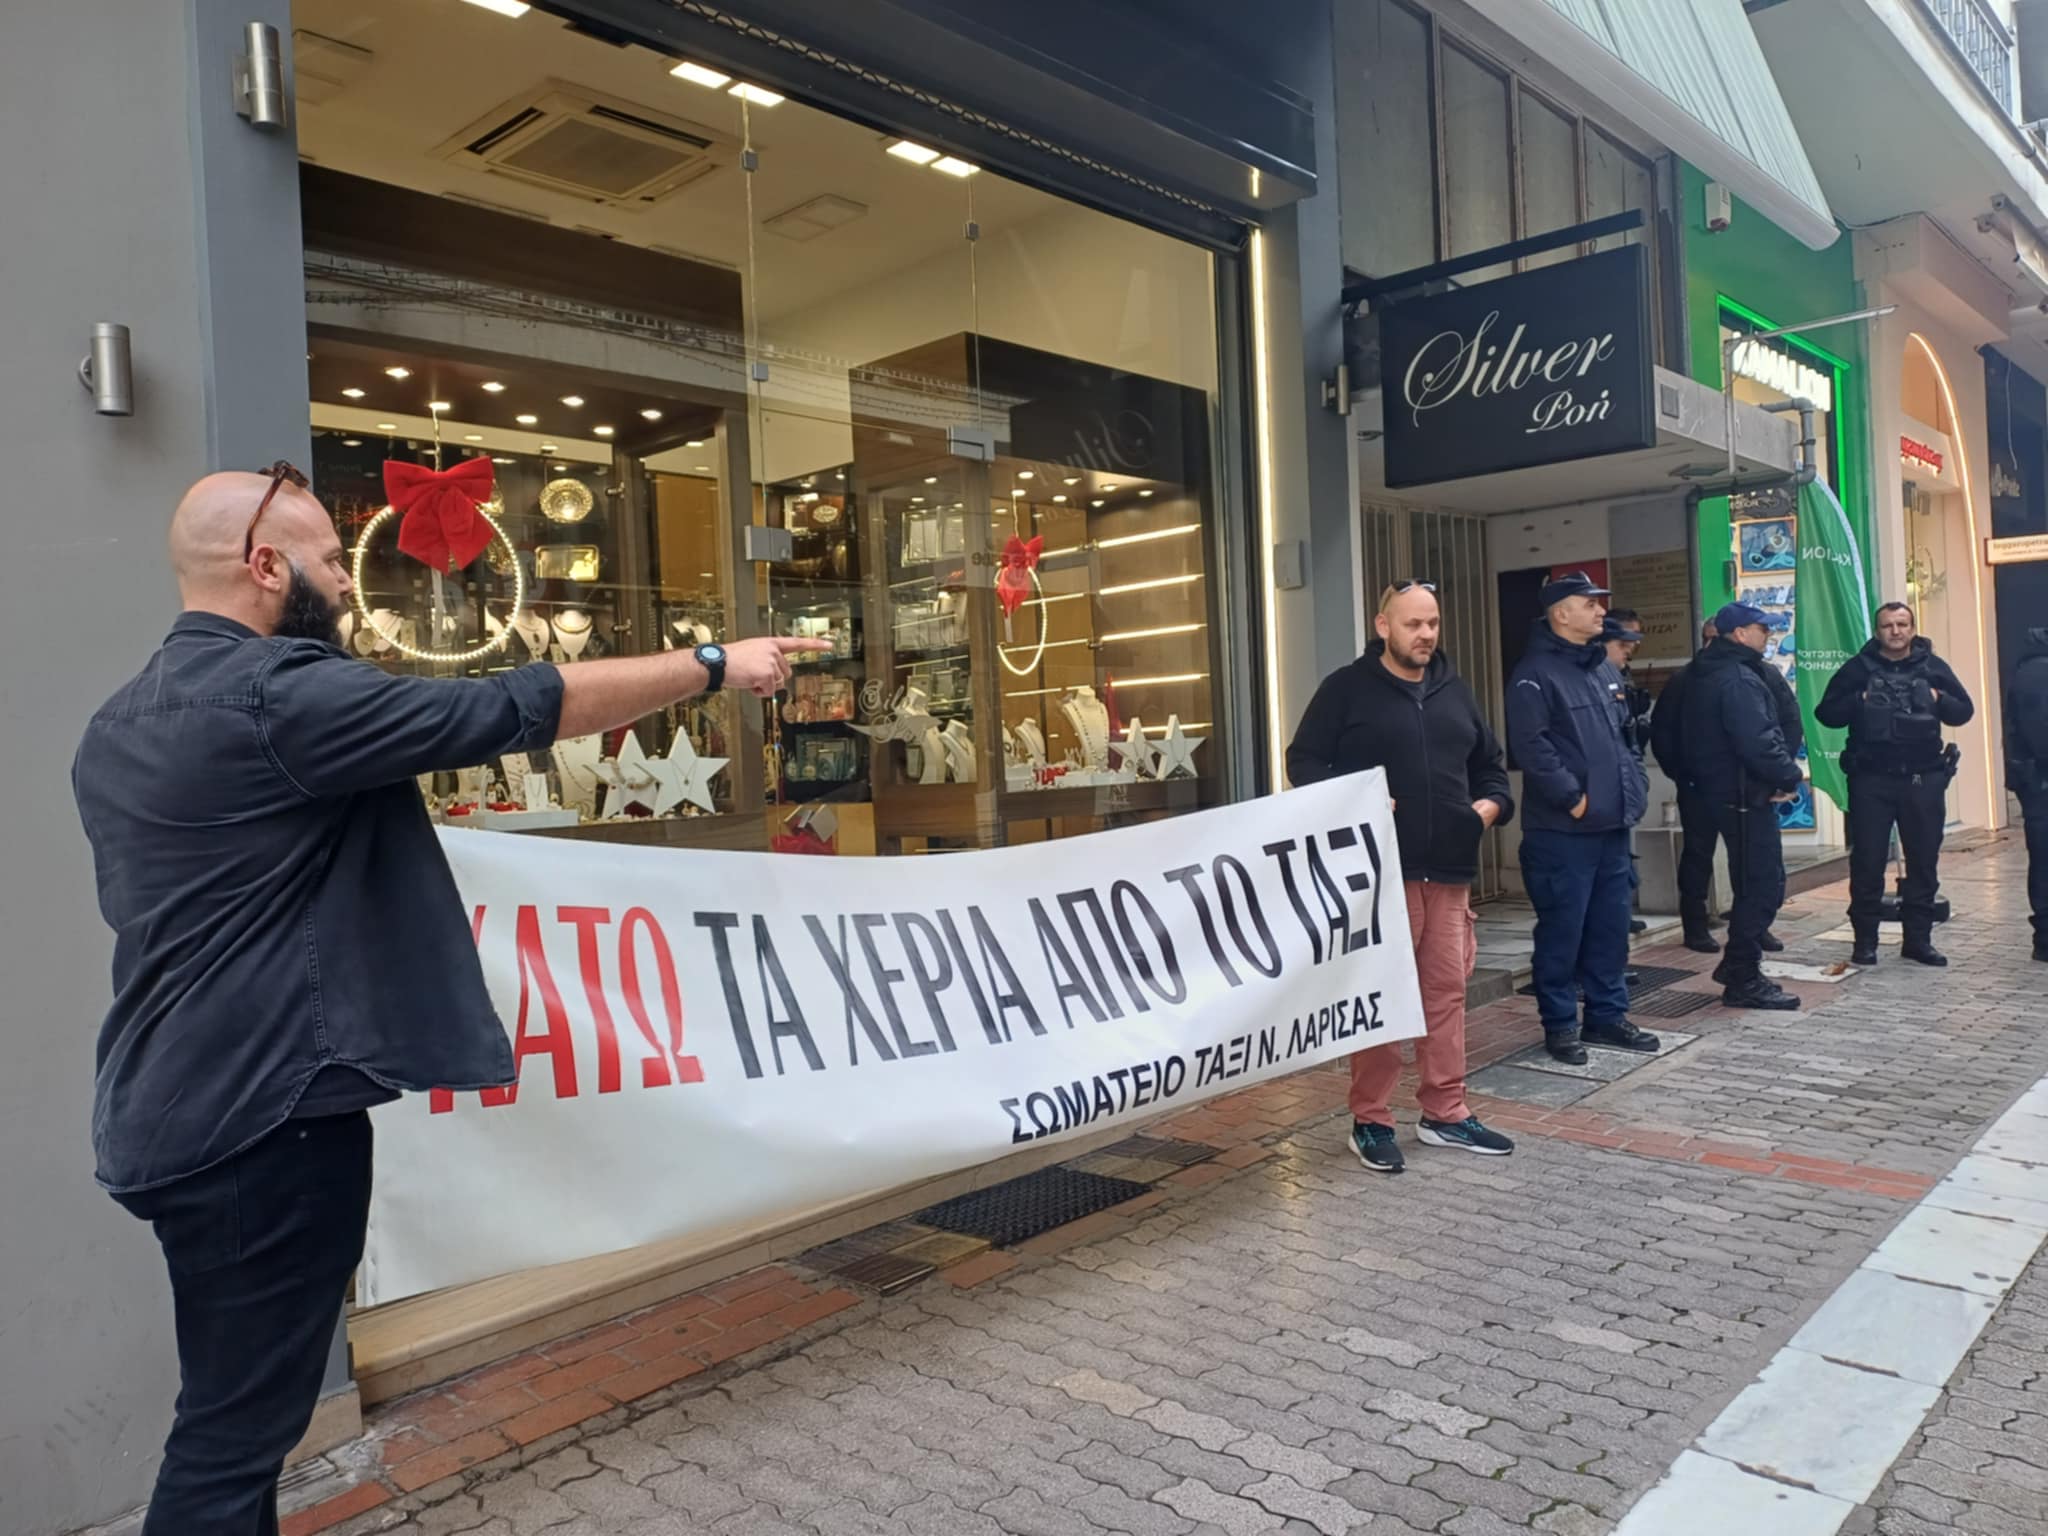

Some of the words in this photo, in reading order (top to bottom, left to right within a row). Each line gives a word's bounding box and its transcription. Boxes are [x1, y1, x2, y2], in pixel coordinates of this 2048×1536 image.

[1404, 310, 1615, 428] Silver
[693, 912, 827, 1080] ΤΑ
[801, 905, 1049, 1066] ΧΕΡΙΑ
[1027, 880, 1188, 1029] ΑΠΟ
[1162, 854, 1283, 988] ΤΟ
[1262, 822, 1383, 966] ΤΑΞΙ
[1000, 1055, 1187, 1145] ΣΩΜΑΤΕΙΟ
[1194, 1034, 1253, 1088] ΤΑΞΙ
[1257, 1026, 1281, 1068] Ν.
[1286, 991, 1384, 1059] ΛΑΡΙΣΑΣ
